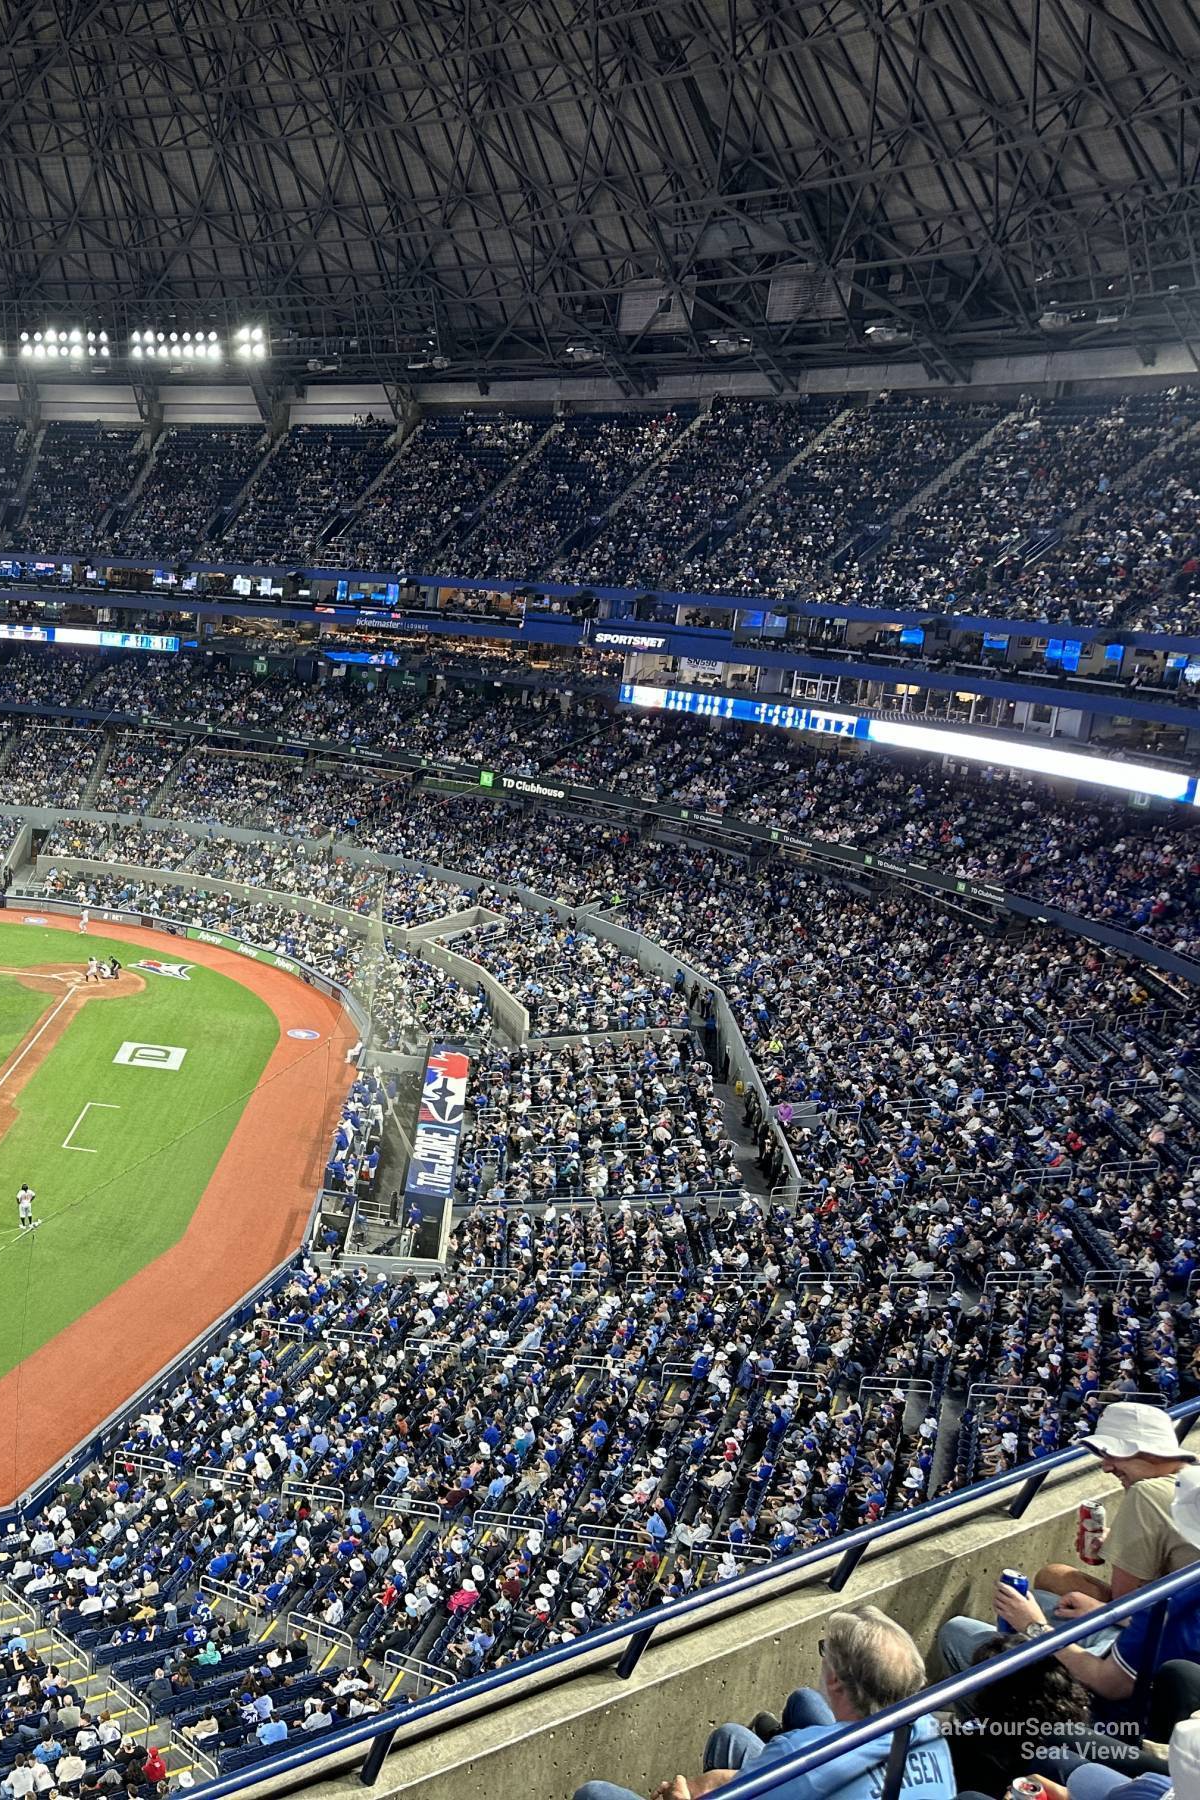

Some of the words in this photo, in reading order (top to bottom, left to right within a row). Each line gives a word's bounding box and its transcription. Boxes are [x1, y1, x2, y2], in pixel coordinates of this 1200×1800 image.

[356, 617, 400, 629] ticketmaster
[595, 633, 665, 648] SPORTSNET
[256, 662, 266, 672] TD
[502, 777, 515, 789] TD
[515, 780, 565, 799] Clubhouse
[413, 1129, 457, 1165] CORE
[417, 1171, 452, 1190] TO
[193, 1629, 207, 1642] 29
[869, 1751, 944, 1799] JNSEN
